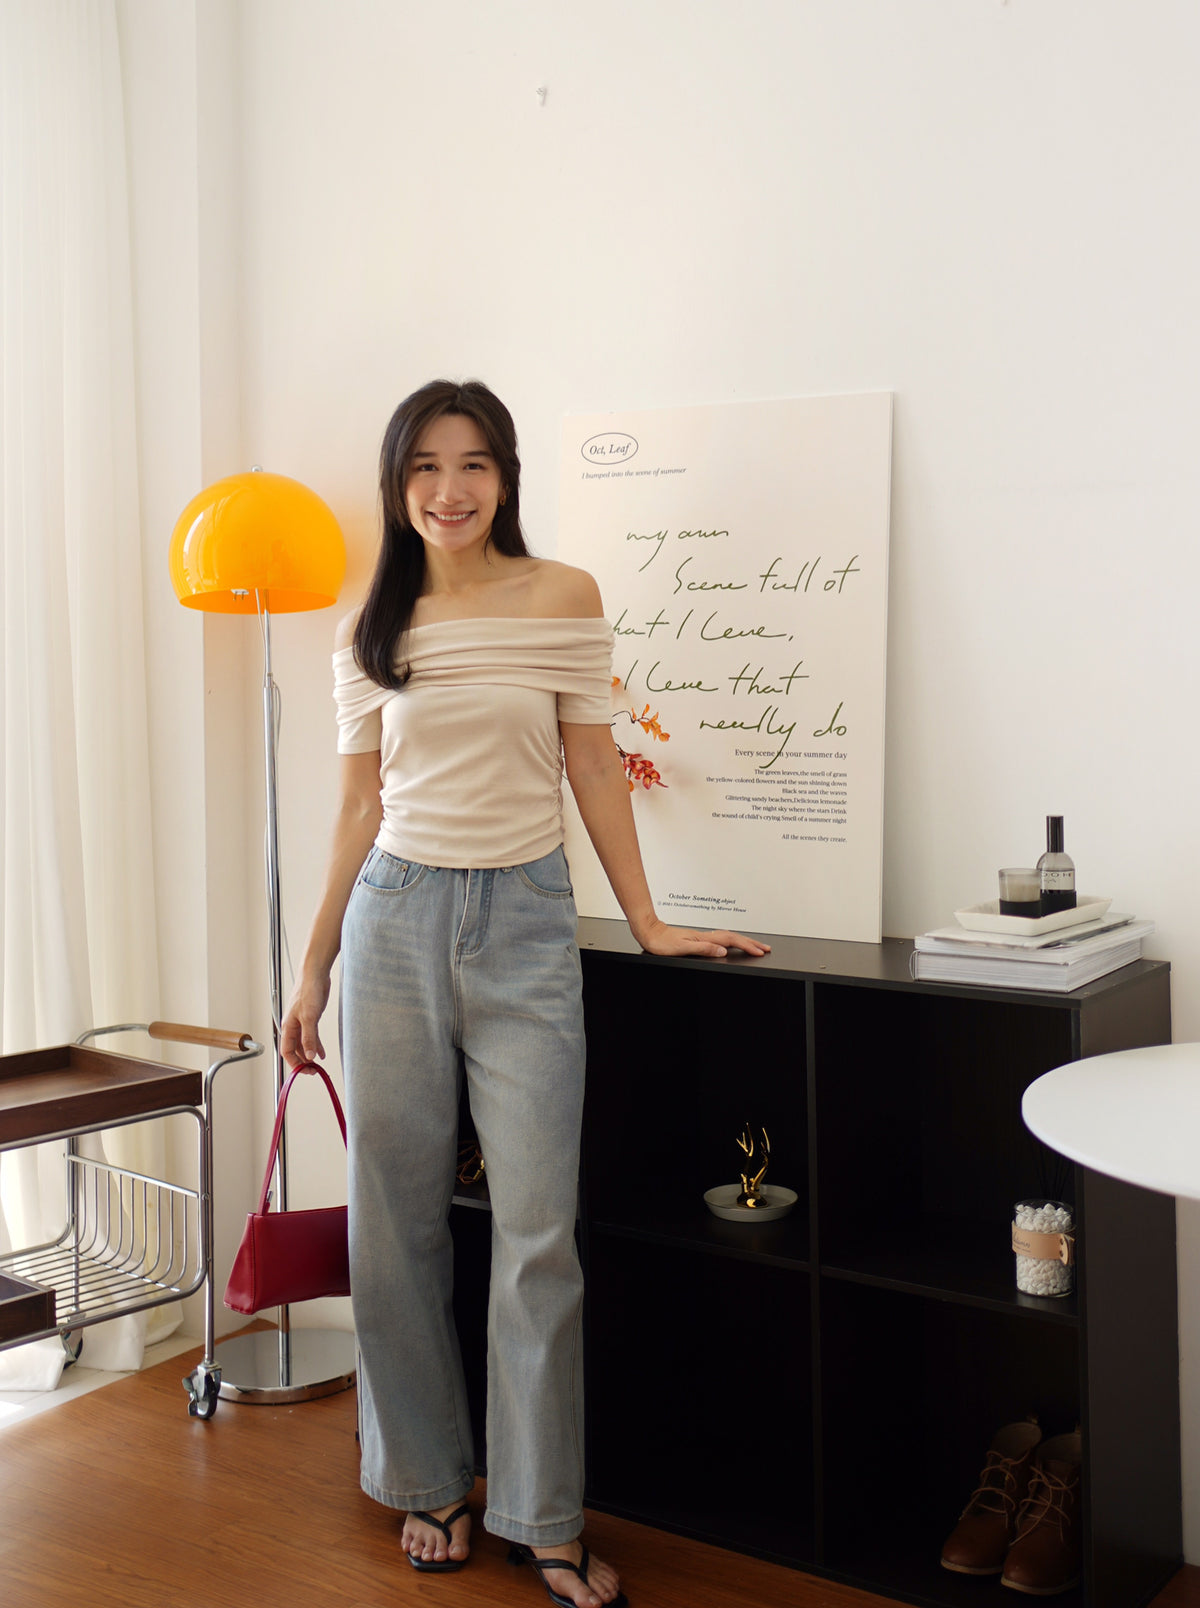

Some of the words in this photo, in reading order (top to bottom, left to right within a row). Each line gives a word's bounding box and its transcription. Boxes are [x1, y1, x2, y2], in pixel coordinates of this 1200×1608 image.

[589, 444, 606, 456] Oct,
[609, 442, 632, 456] Leaf
[585, 471, 611, 480] bumped
[624, 469, 633, 477] the
[652, 468, 661, 477] of
[626, 530, 669, 572] my
[613, 608, 670, 638] hat
[728, 660, 810, 695] that
[812, 702, 848, 738] do
[735, 748, 754, 758] Every
[785, 751, 802, 759] your
[834, 751, 847, 760] day
